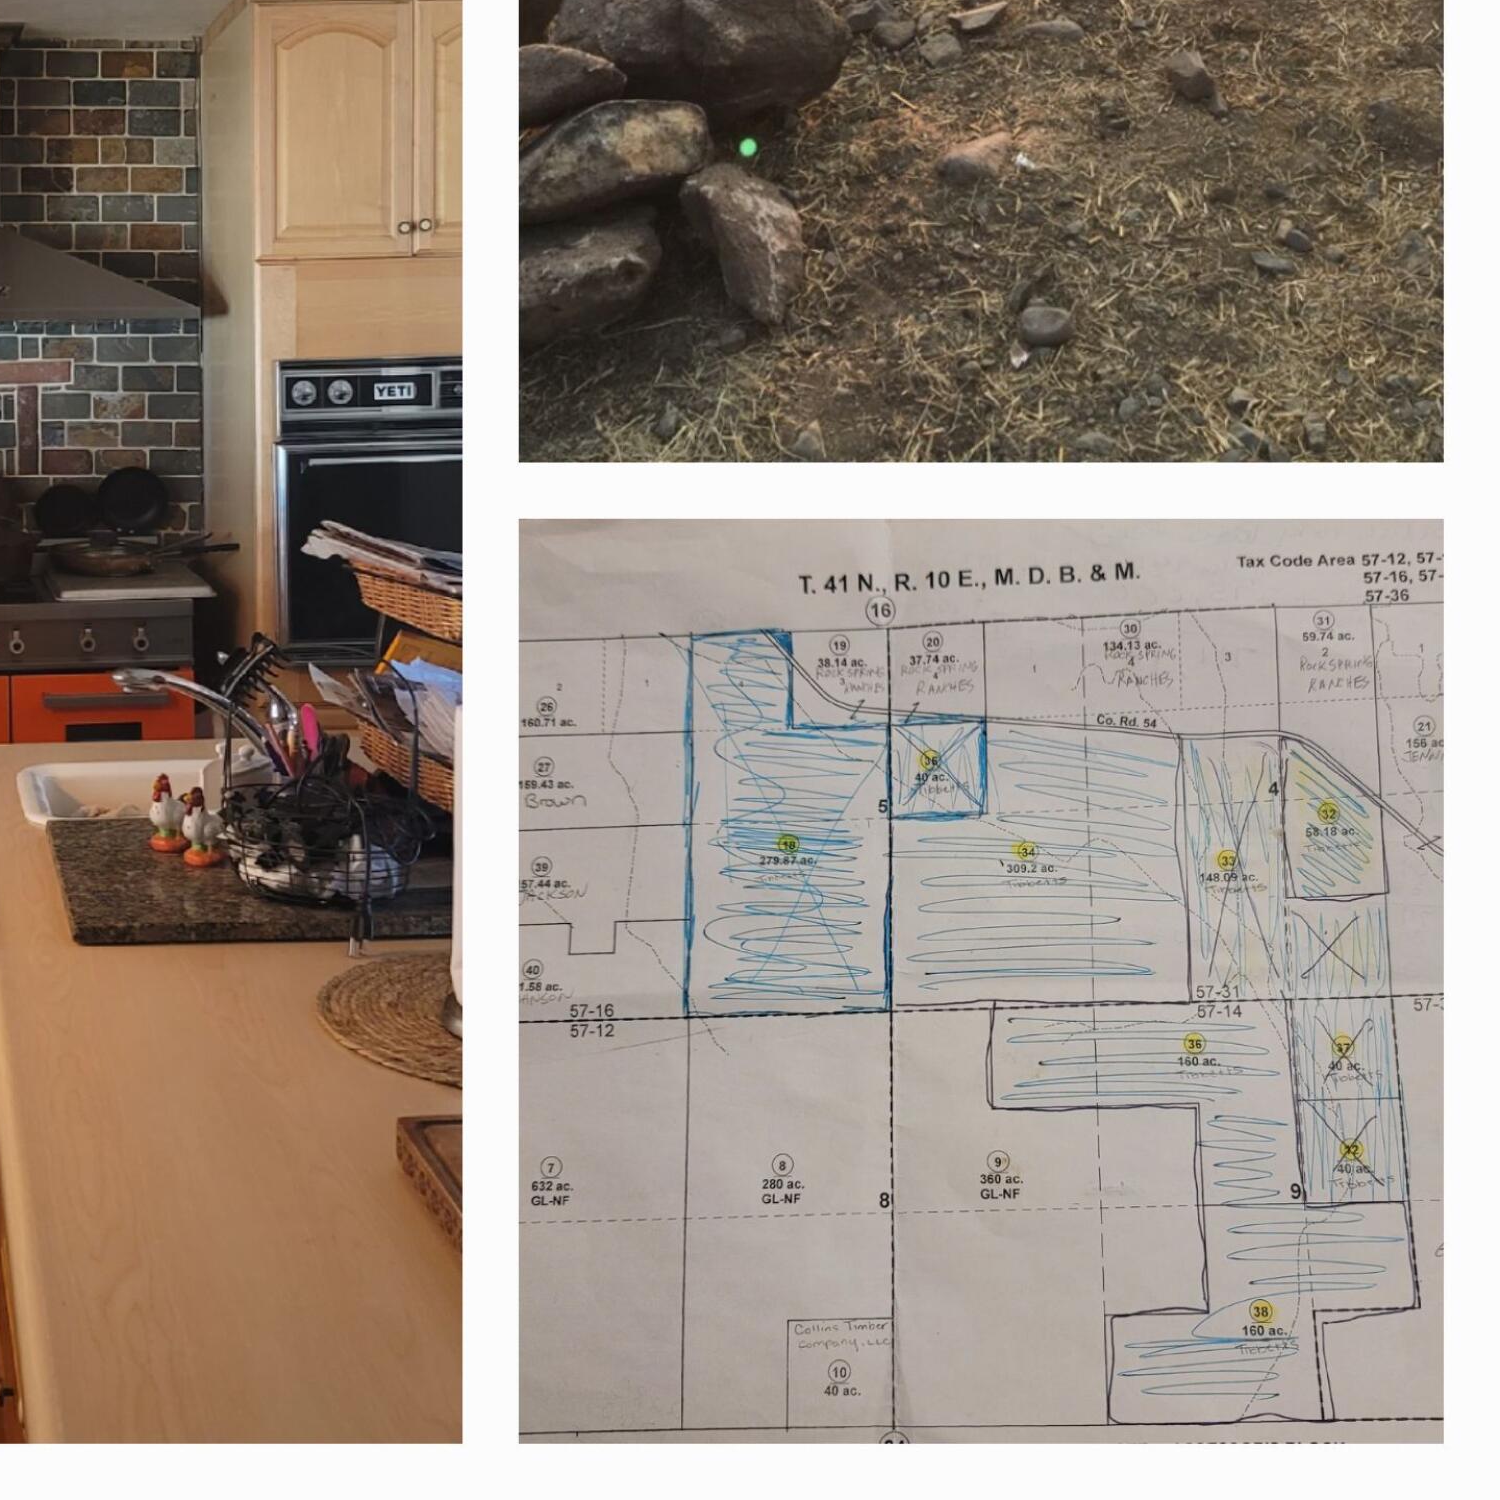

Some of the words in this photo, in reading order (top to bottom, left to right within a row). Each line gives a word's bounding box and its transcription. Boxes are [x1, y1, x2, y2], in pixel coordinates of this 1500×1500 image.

[375, 385, 412, 398] YETI
[1236, 555, 1265, 568] Tax
[1270, 554, 1313, 568] Code
[1317, 553, 1355, 567] Area
[1361, 552, 1411, 567] 57-12,
[799, 574, 816, 594] T.
[824, 574, 848, 594] 41
[895, 572, 917, 592] R.
[925, 570, 950, 589] 10
[994, 567, 1020, 586] M.
[1028, 566, 1051, 585] D.
[1059, 565, 1081, 584] B.
[1090, 563, 1106, 582] &
[1115, 561, 1140, 580] M.
[1363, 569, 1413, 585] 57-16,
[1365, 588, 1410, 602] 57-36
[1302, 631, 1334, 642] 59.74
[1337, 632, 1355, 642] ac.
[1102, 640, 1141, 652] 134.13
[1144, 640, 1162, 650] ac.
[817, 658, 847, 668] 38.14
[851, 658, 868, 668] ac.
[909, 654, 939, 666] 37.74
[943, 654, 960, 664] ac.
[560, 719, 577, 727] ac.
[1097, 713, 1116, 726] Co.
[1120, 715, 1140, 728] Rd.
[1143, 718, 1157, 729] 54
[932, 774, 949, 782] ac.
[557, 781, 574, 789] ac.
[1268, 781, 1279, 796] 4
[525, 793, 587, 809] Brown
[878, 799, 889, 813] 5
[1306, 827, 1337, 837] 58.18
[1341, 828, 1359, 836] ac.
[759, 856, 797, 865] 279.87
[1006, 864, 1037, 873] 309.2
[1041, 865, 1058, 873] ac.
[1200, 873, 1238, 882] 148.09
[554, 880, 571, 888] ac.
[545, 983, 563, 991] ac.
[1196, 985, 1240, 998] 57-31
[570, 1003, 614, 1017] 57-16
[1197, 1004, 1242, 1018] 57-14
[570, 1023, 614, 1037] 57-12
[1178, 1056, 1199, 1066] 160
[1202, 1058, 1220, 1066] ac.
[1337, 1164, 1351, 1173] 40
[762, 1179, 783, 1189] 280
[787, 1180, 805, 1189] ac.
[980, 1173, 1001, 1184] 360
[1005, 1175, 1023, 1184] ac.
[531, 1180, 553, 1191] 632
[556, 1182, 574, 1191] ac.
[1290, 1183, 1301, 1199] 9
[761, 1193, 800, 1204] GL-NF
[980, 1188, 1020, 1199] GL-NF
[531, 1195, 570, 1206] GL-NF
[879, 1192, 890, 1208] 8
[794, 1323, 839, 1335] Collins
[844, 1320, 889, 1331] Timber
[1242, 1325, 1265, 1336] 160
[1268, 1327, 1287, 1336] ac.
[824, 1386, 839, 1396] 40
[843, 1387, 861, 1396] ac.
